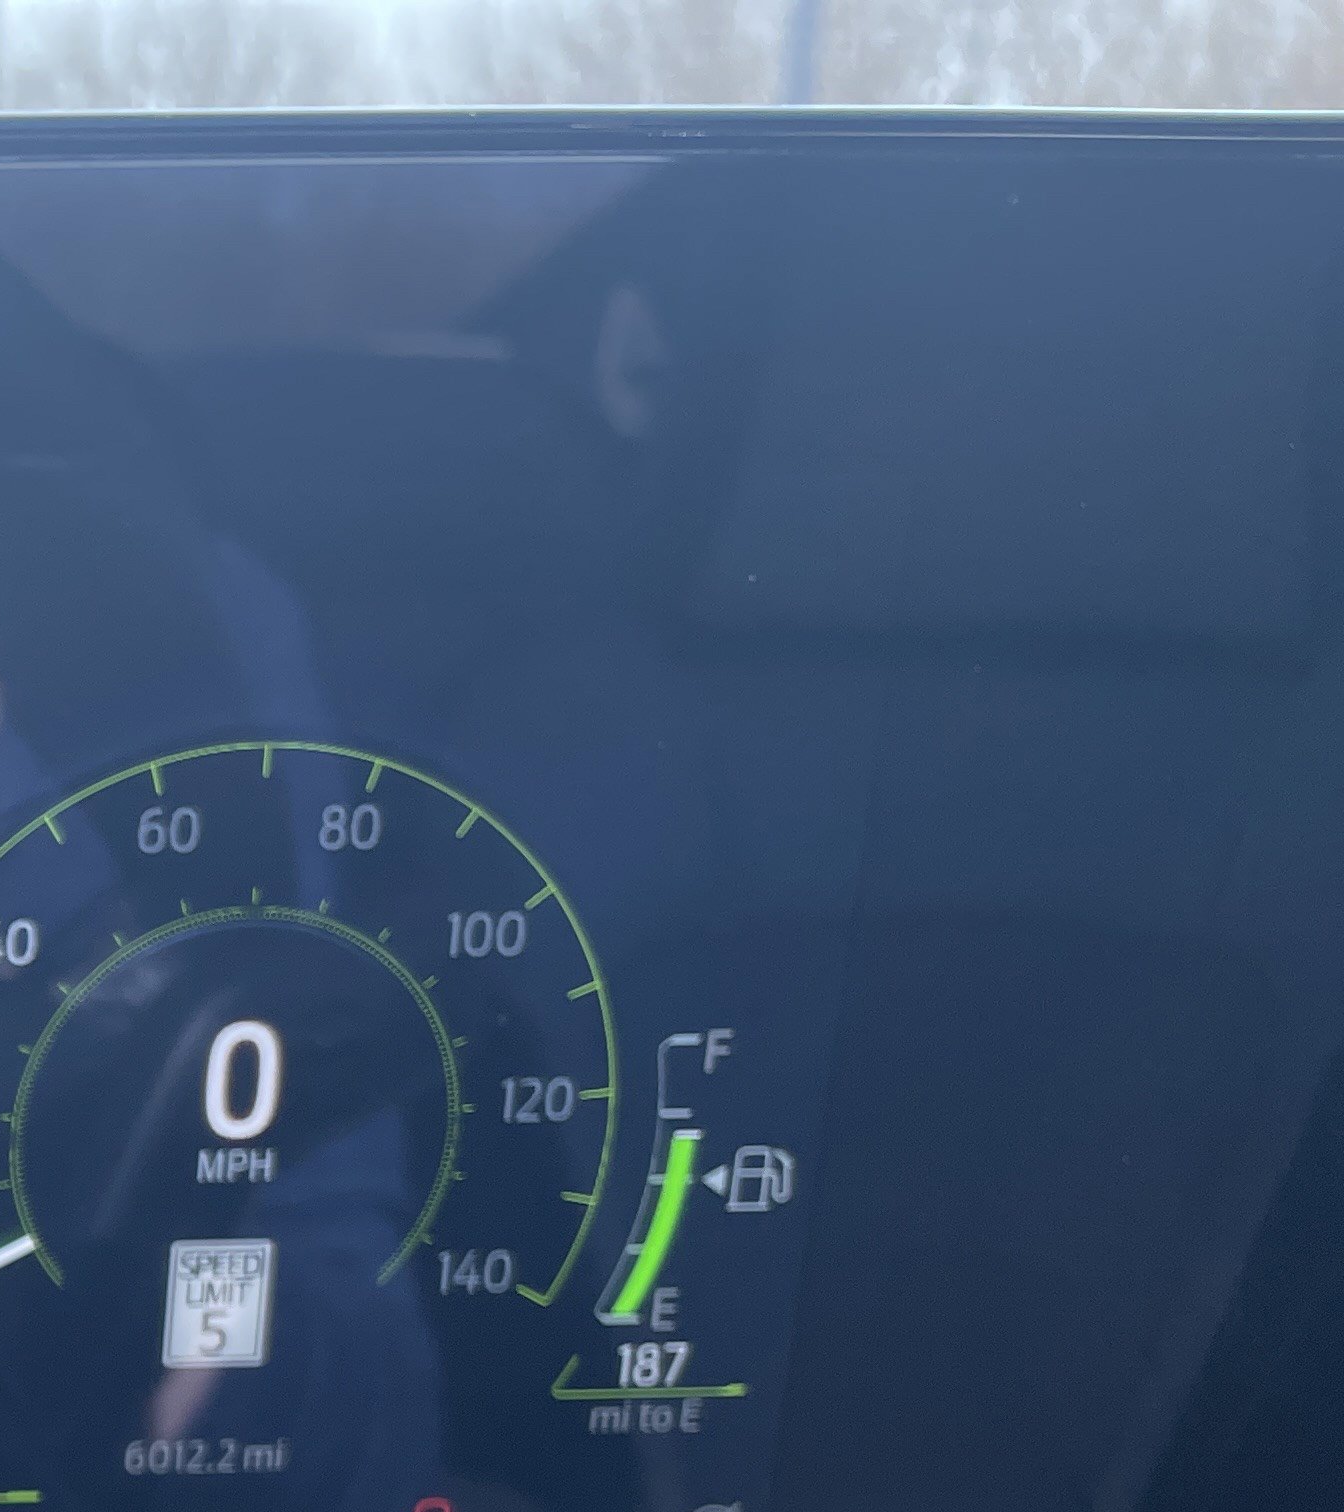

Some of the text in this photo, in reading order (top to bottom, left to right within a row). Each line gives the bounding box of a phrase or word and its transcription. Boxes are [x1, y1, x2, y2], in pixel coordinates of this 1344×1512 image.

[137, 806, 201, 854] 60
[317, 804, 382, 851] 80
[448, 911, 527, 959] 100
[703, 1027, 734, 1075] F
[205, 1020, 283, 1140] 0
[501, 1075, 574, 1124] 120
[196, 1148, 275, 1184] MPH
[180, 1251, 263, 1277] SPEED
[438, 1248, 512, 1295] 140
[184, 1280, 252, 1306] LIMIT
[650, 1287, 680, 1333] E
[200, 1310, 229, 1355] 5
[617, 1342, 689, 1388] 187
[588, 1398, 706, 1435] mi to E
[123, 1437, 287, 1475] 6012.2 mi
